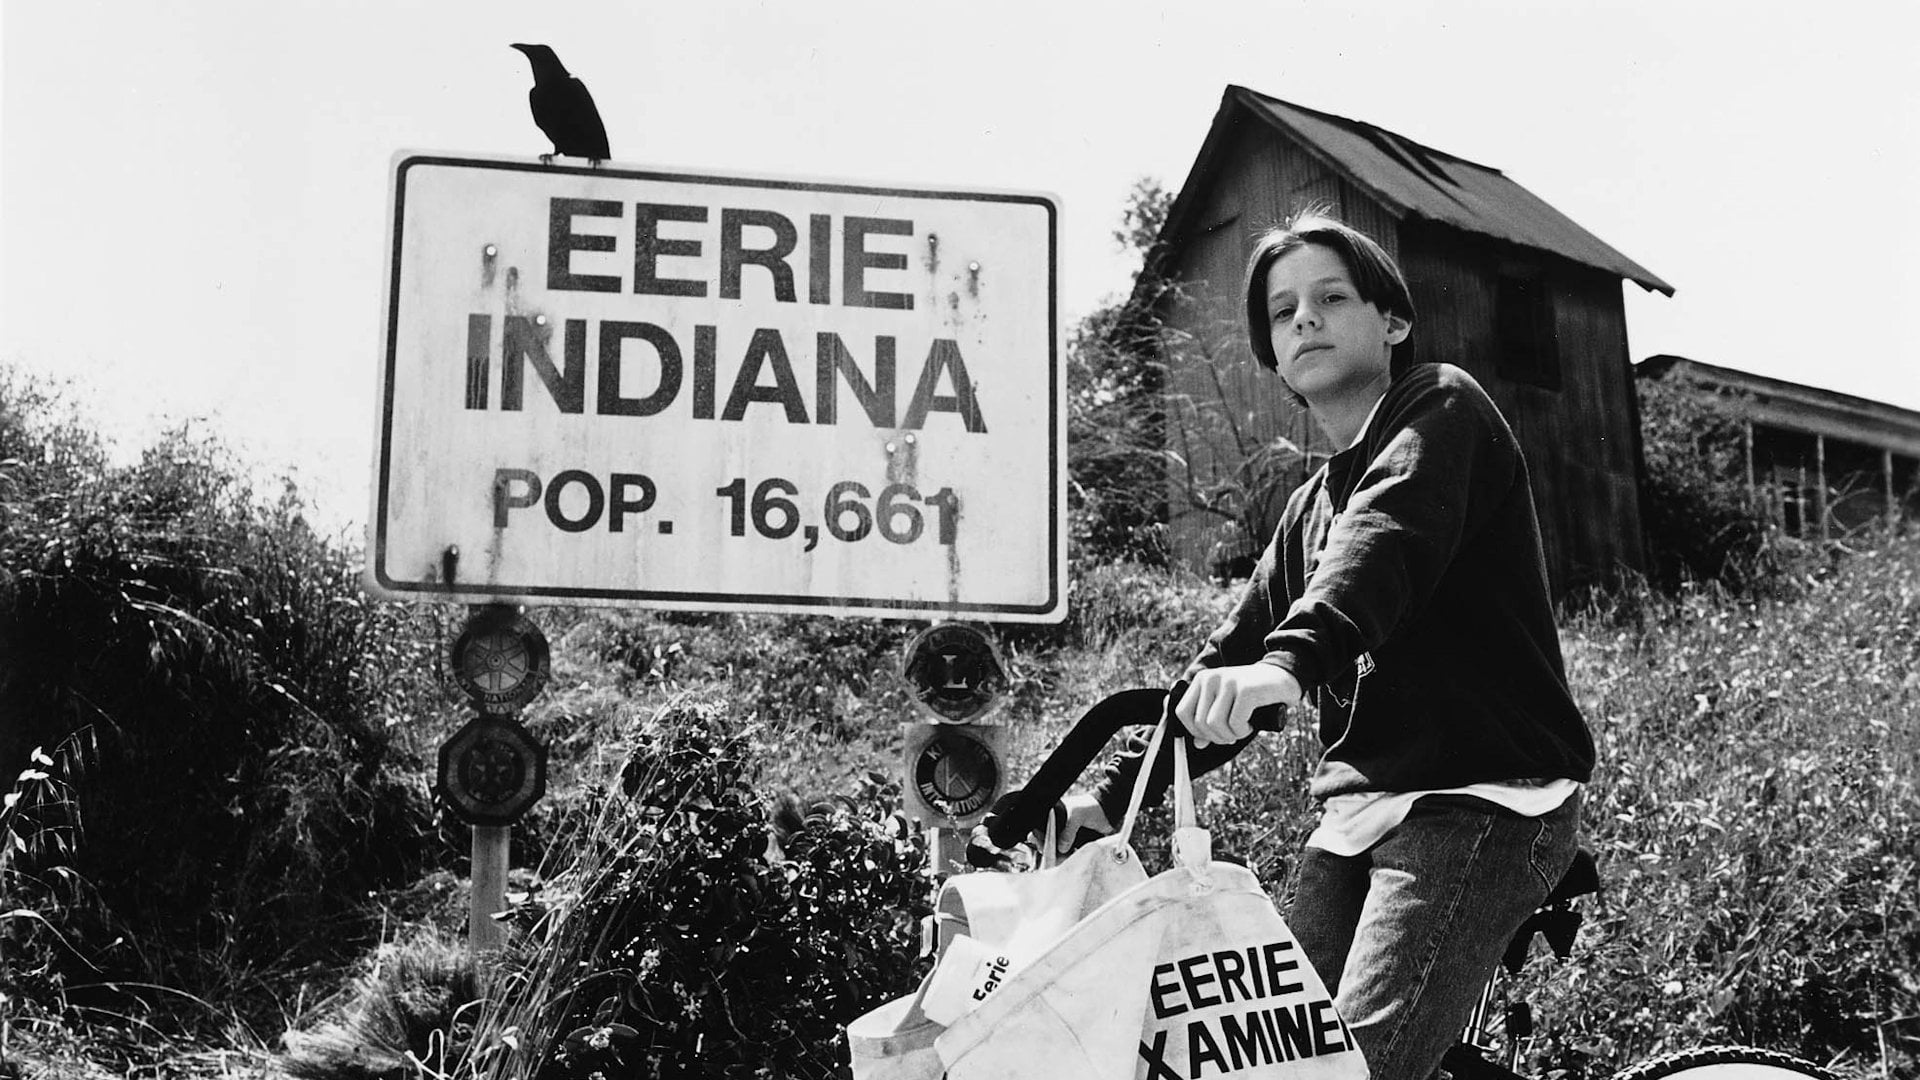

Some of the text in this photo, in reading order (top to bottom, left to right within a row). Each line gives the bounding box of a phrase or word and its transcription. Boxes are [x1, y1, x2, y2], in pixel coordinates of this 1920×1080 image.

[546, 197, 915, 311] EERIE
[465, 313, 989, 434] INDIANA
[493, 468, 957, 553] POP. 16,661
[973, 956, 1010, 1001] Eerie
[1150, 940, 1305, 1020] EERIE
